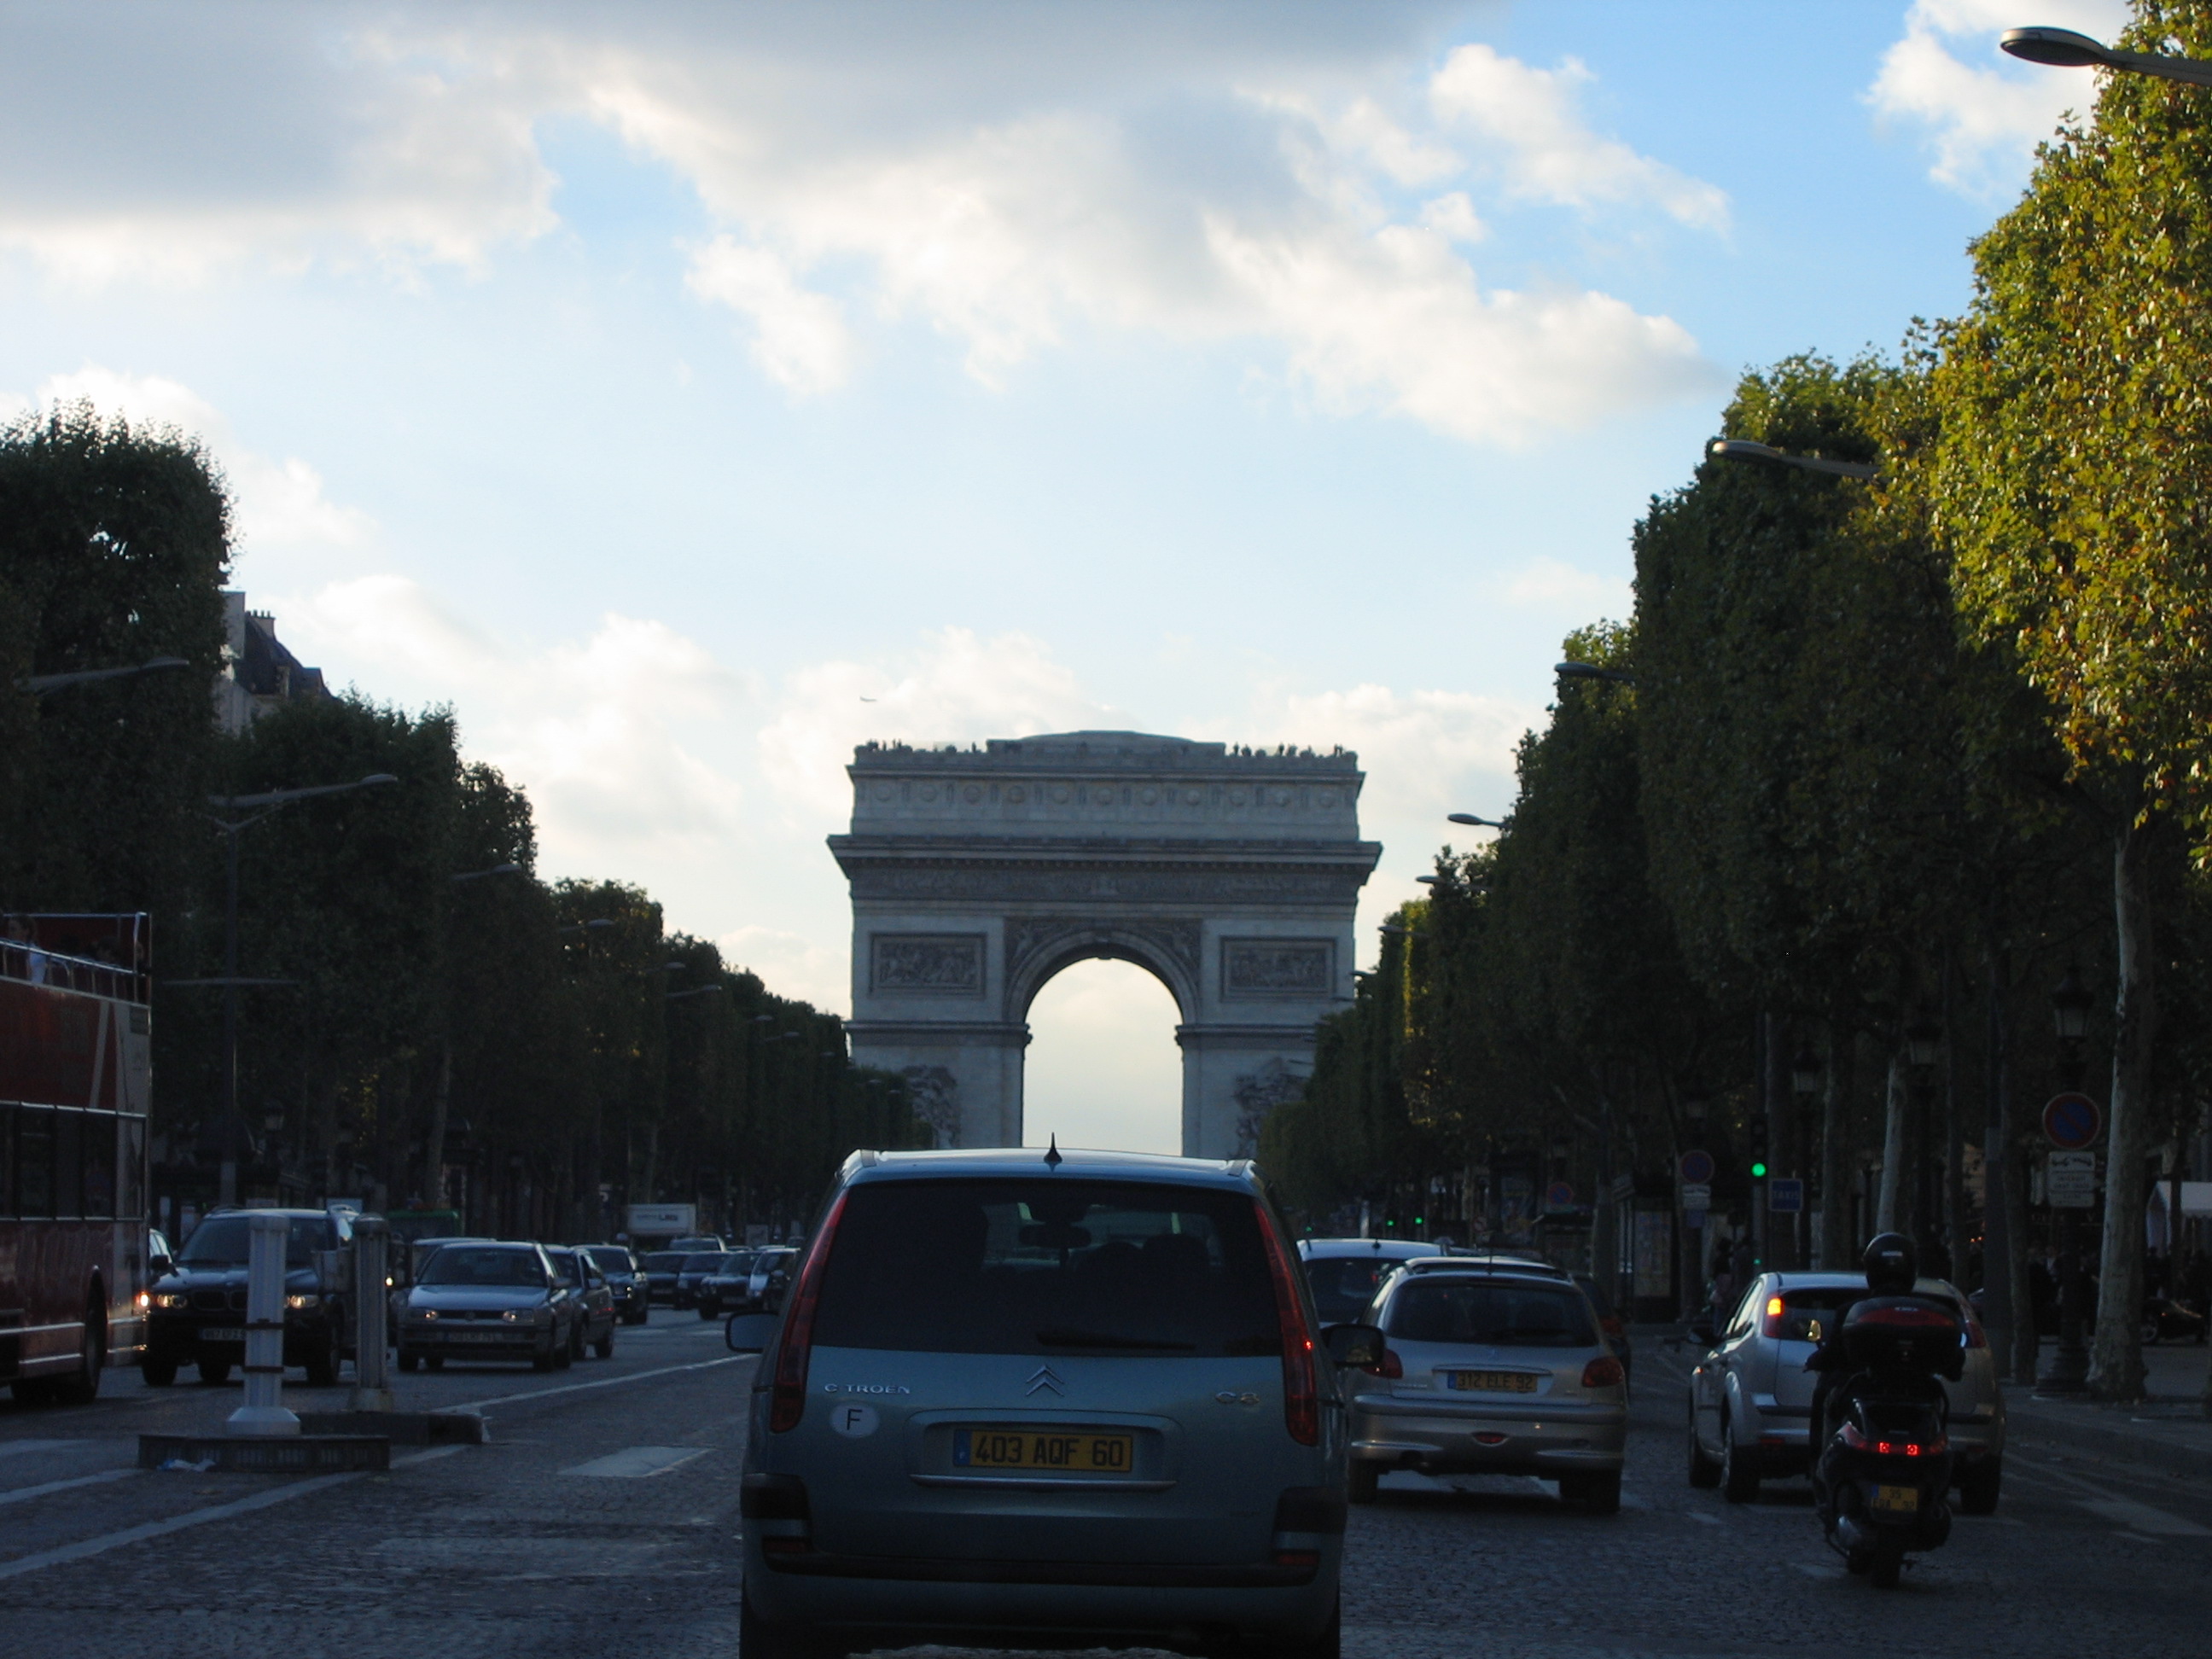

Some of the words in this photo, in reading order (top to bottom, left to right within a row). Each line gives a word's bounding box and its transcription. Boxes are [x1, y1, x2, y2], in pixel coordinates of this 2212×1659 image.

[1516, 1375, 1534, 1391] 92
[1215, 1391, 1260, 1405] C8
[847, 1408, 863, 1430] F
[976, 1435, 1023, 1464] 403
[1033, 1437, 1080, 1465] AQF
[1092, 1440, 1124, 1467] 60
